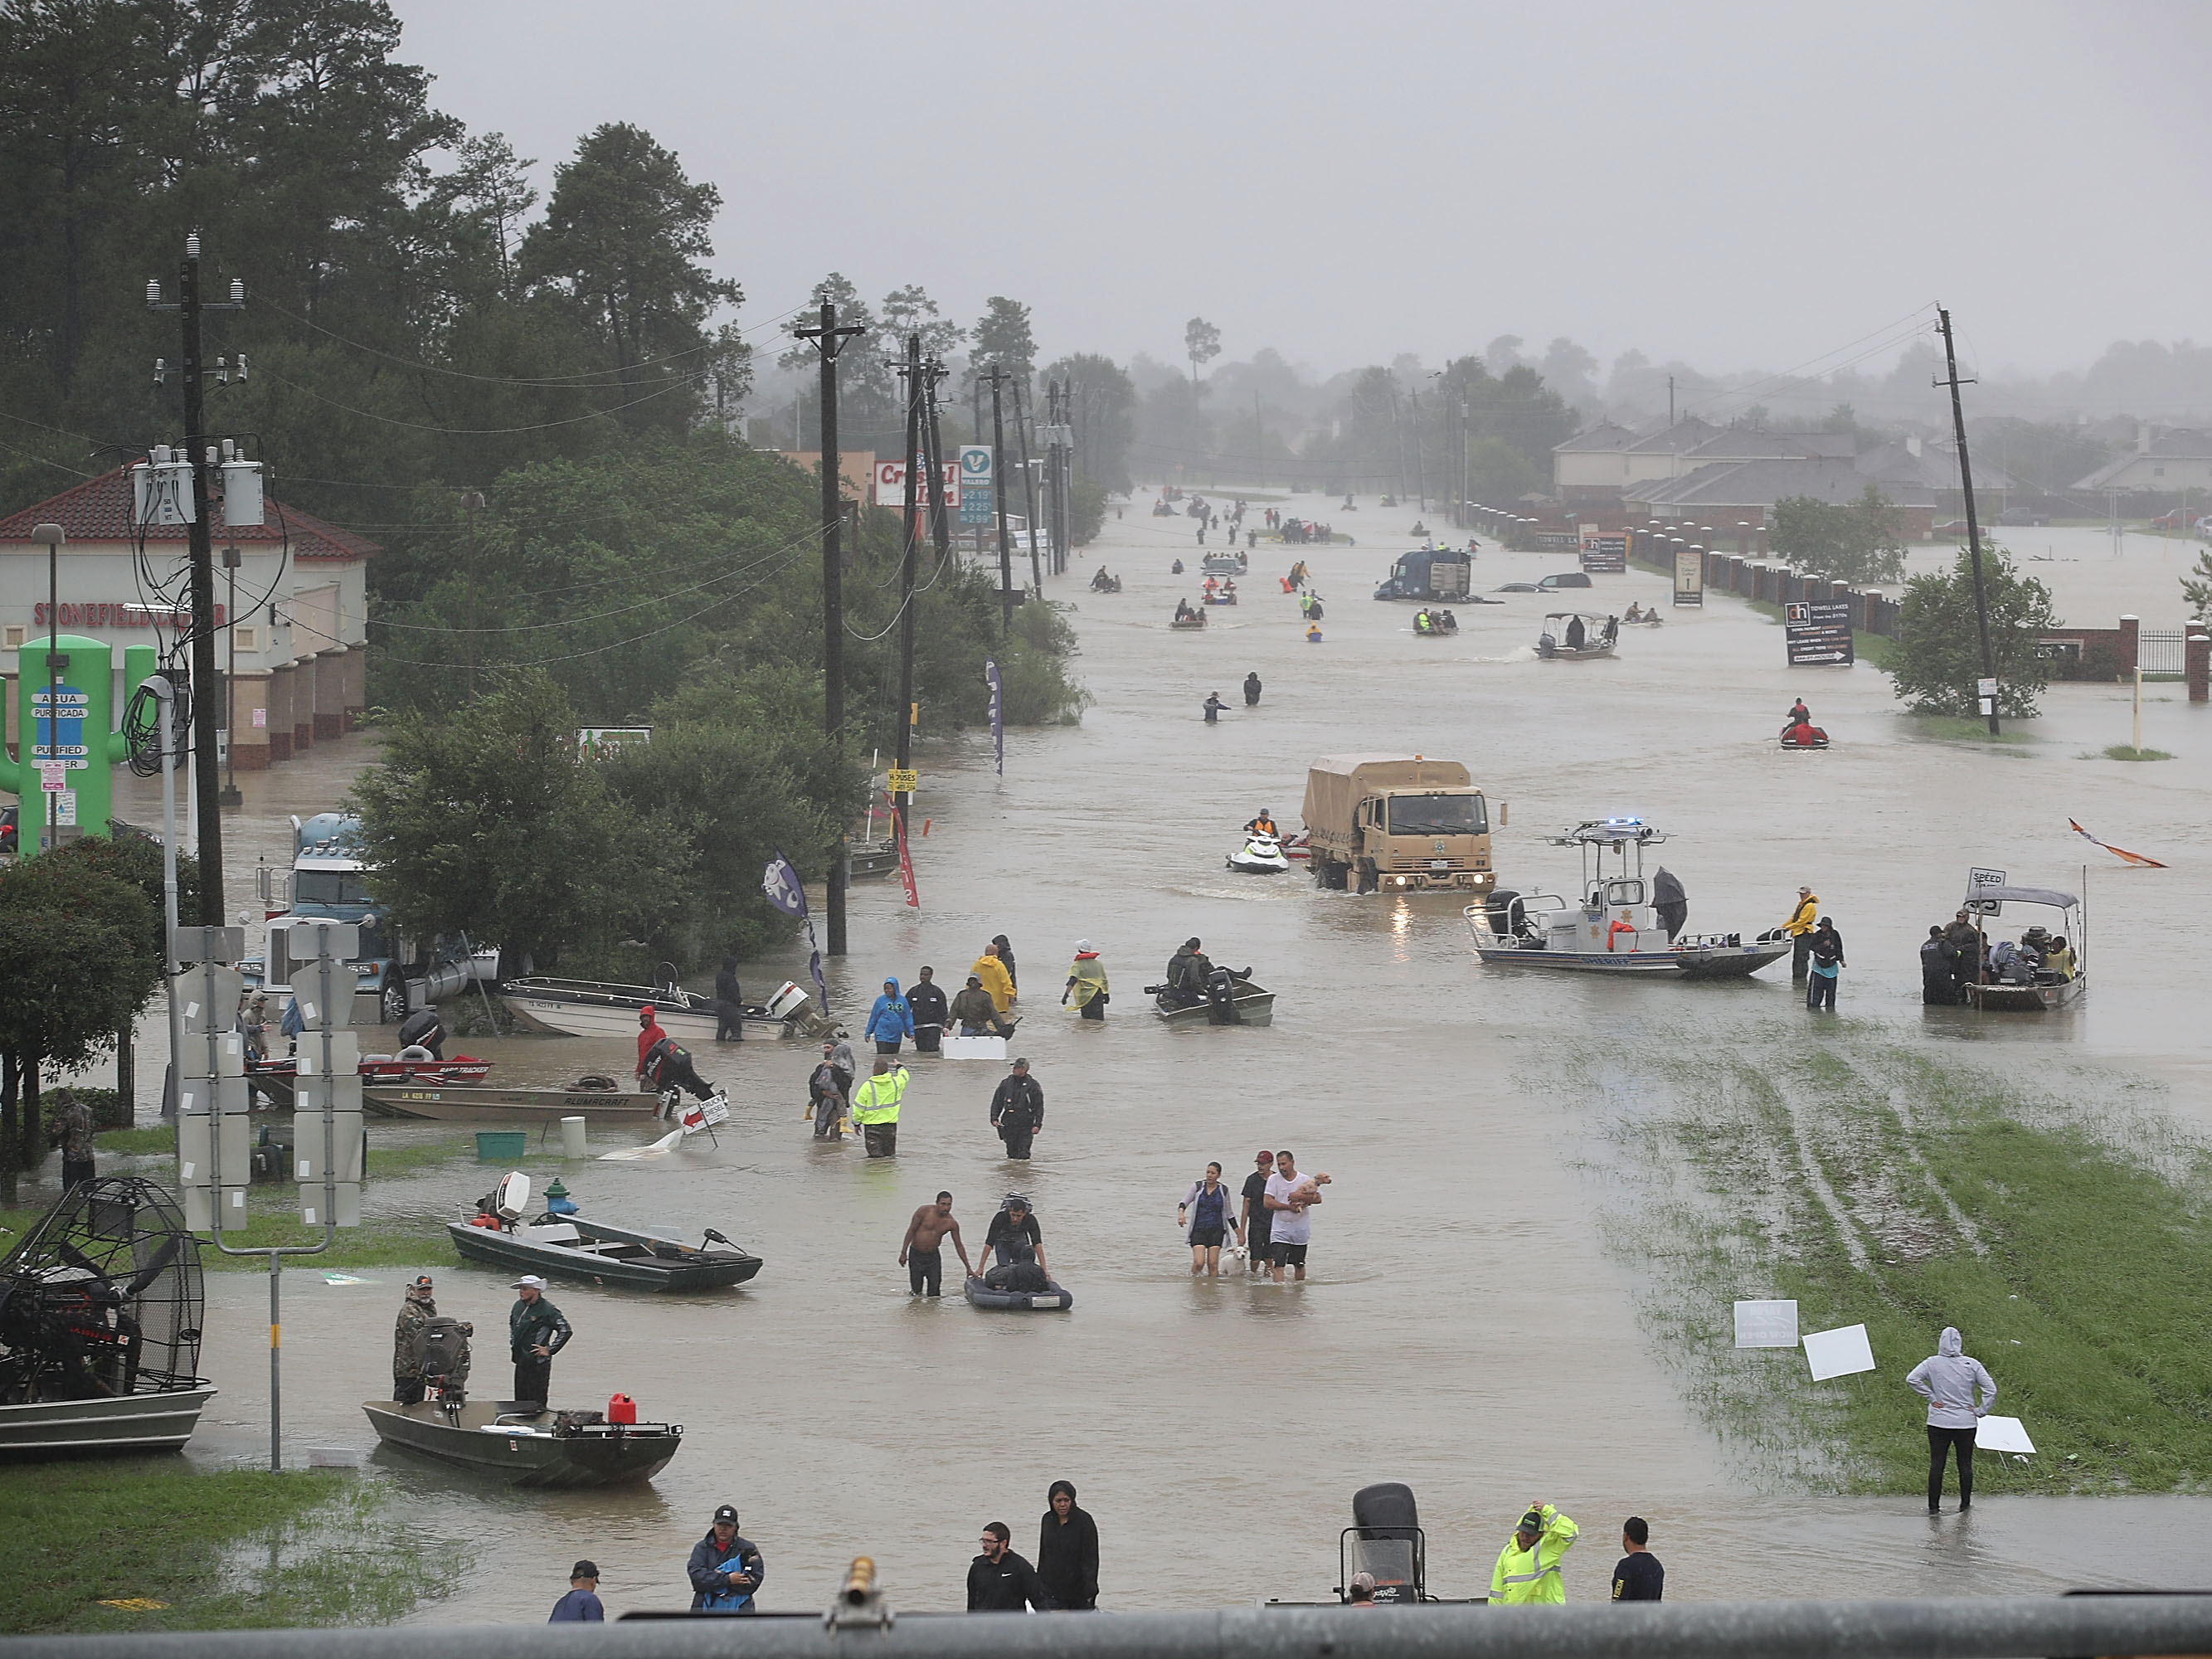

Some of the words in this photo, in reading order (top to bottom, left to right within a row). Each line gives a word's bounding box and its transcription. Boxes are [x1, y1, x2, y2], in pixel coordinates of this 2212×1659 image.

[1973, 873, 2001, 883] SPEED
[1582, 957, 1632, 966] SHERIFF
[564, 1097, 630, 1107] ALUMACRAFT
[701, 1096, 722, 1109] TRUCK
[705, 1104, 726, 1117] DIESEL
